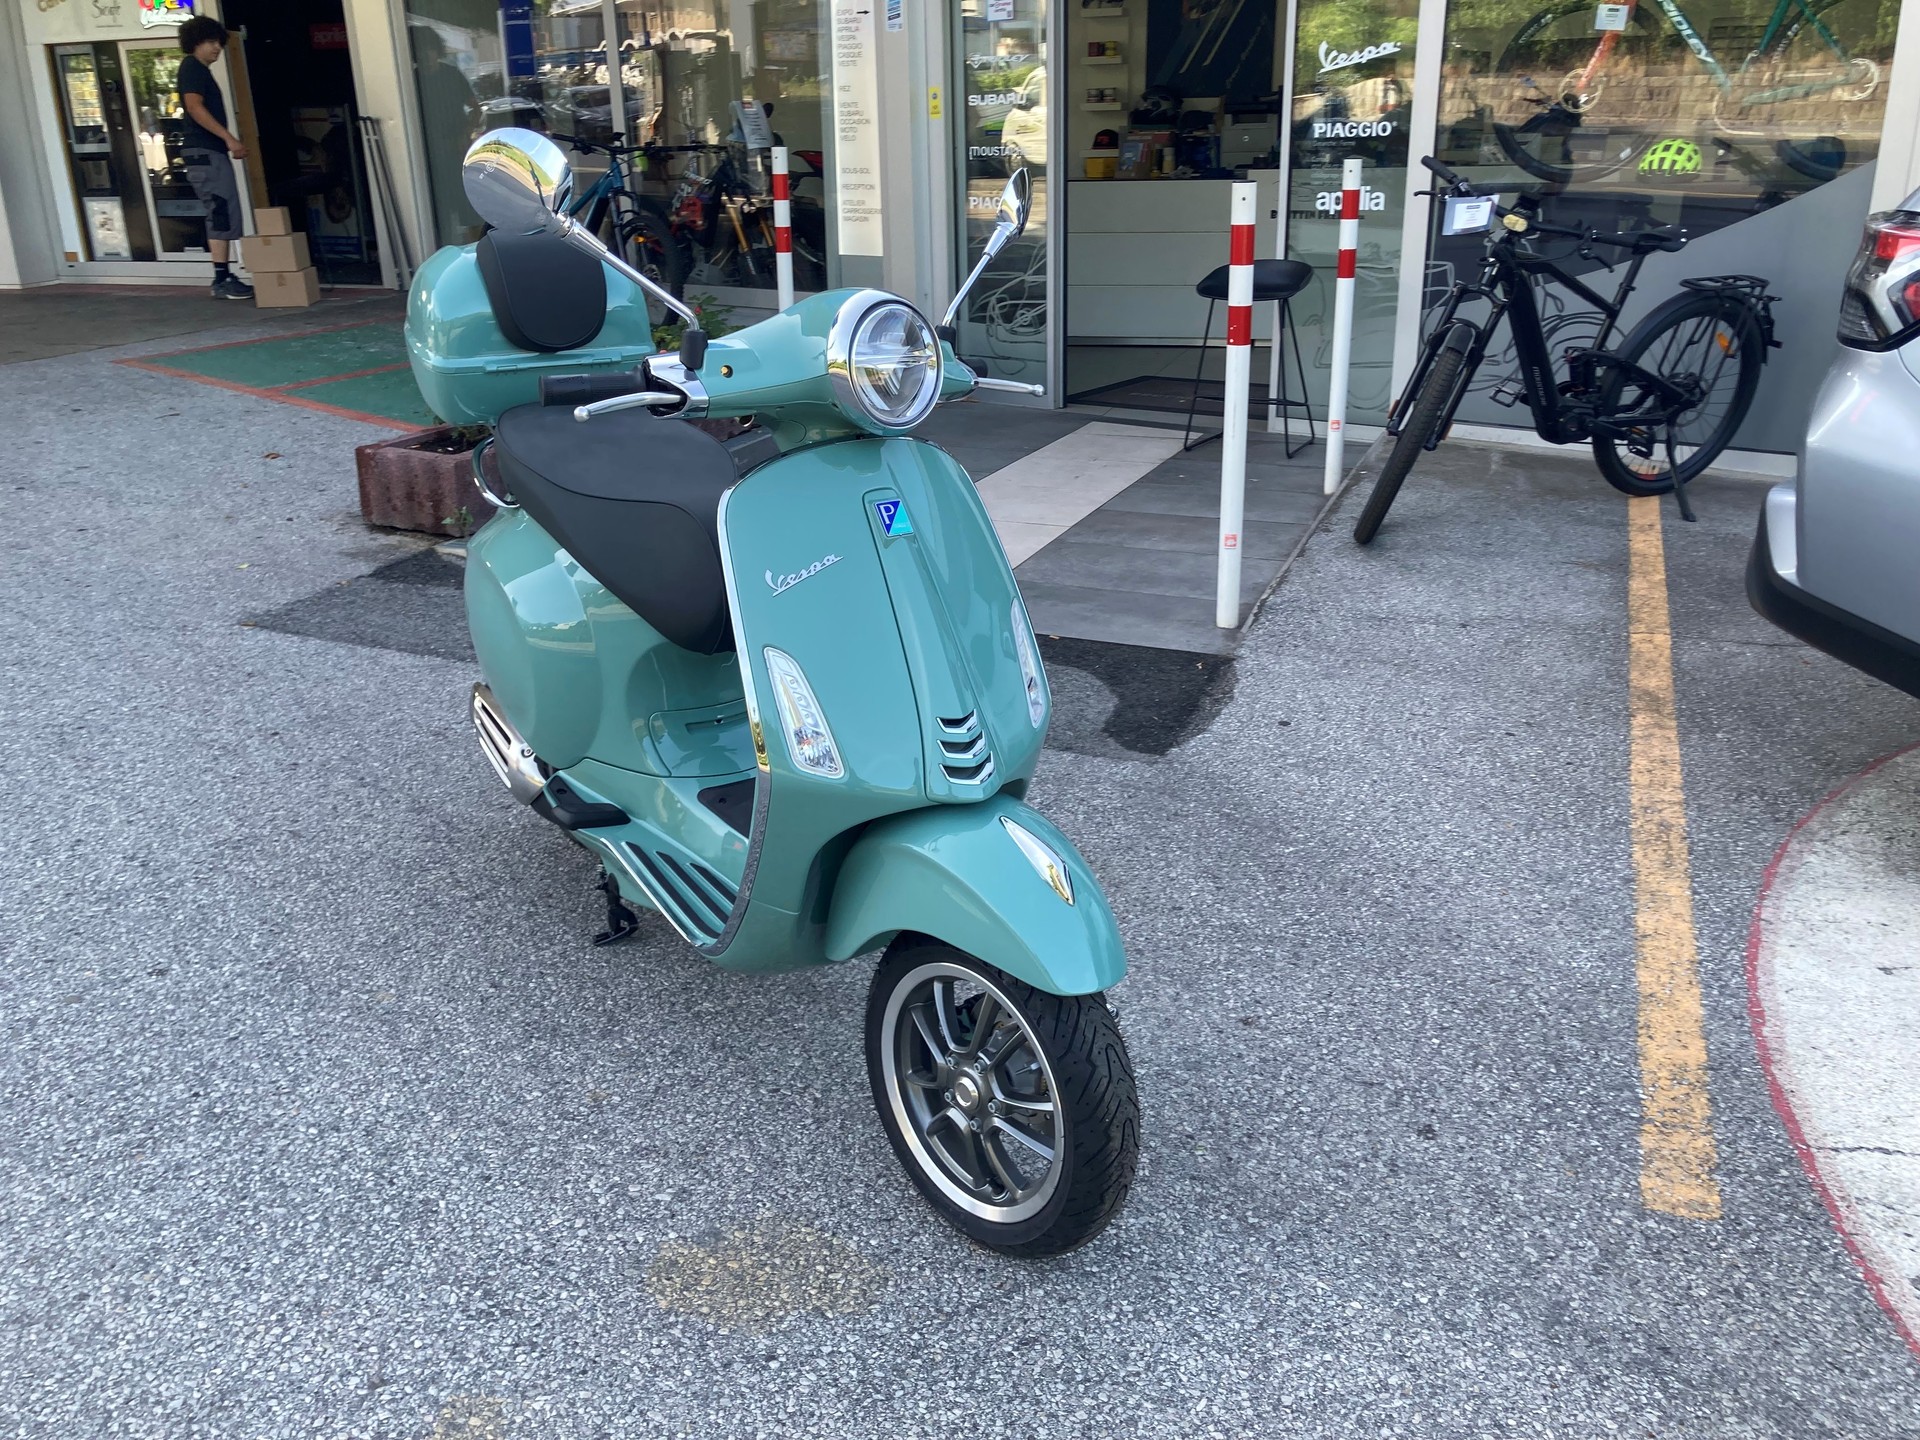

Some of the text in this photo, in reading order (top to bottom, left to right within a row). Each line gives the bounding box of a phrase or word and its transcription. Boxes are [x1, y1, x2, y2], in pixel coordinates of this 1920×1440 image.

[837, 17, 862, 25] SUBARU
[1318, 40, 1401, 74] Vespa
[967, 93, 1028, 106] SUBARU
[1312, 121, 1392, 138] PIAGGIO
[968, 197, 1002, 210] PIAG
[1315, 185, 1386, 215] aplia
[1270, 209, 1315, 220] BTTIN
[878, 503, 896, 525] P
[764, 553, 844, 598] Vespa
